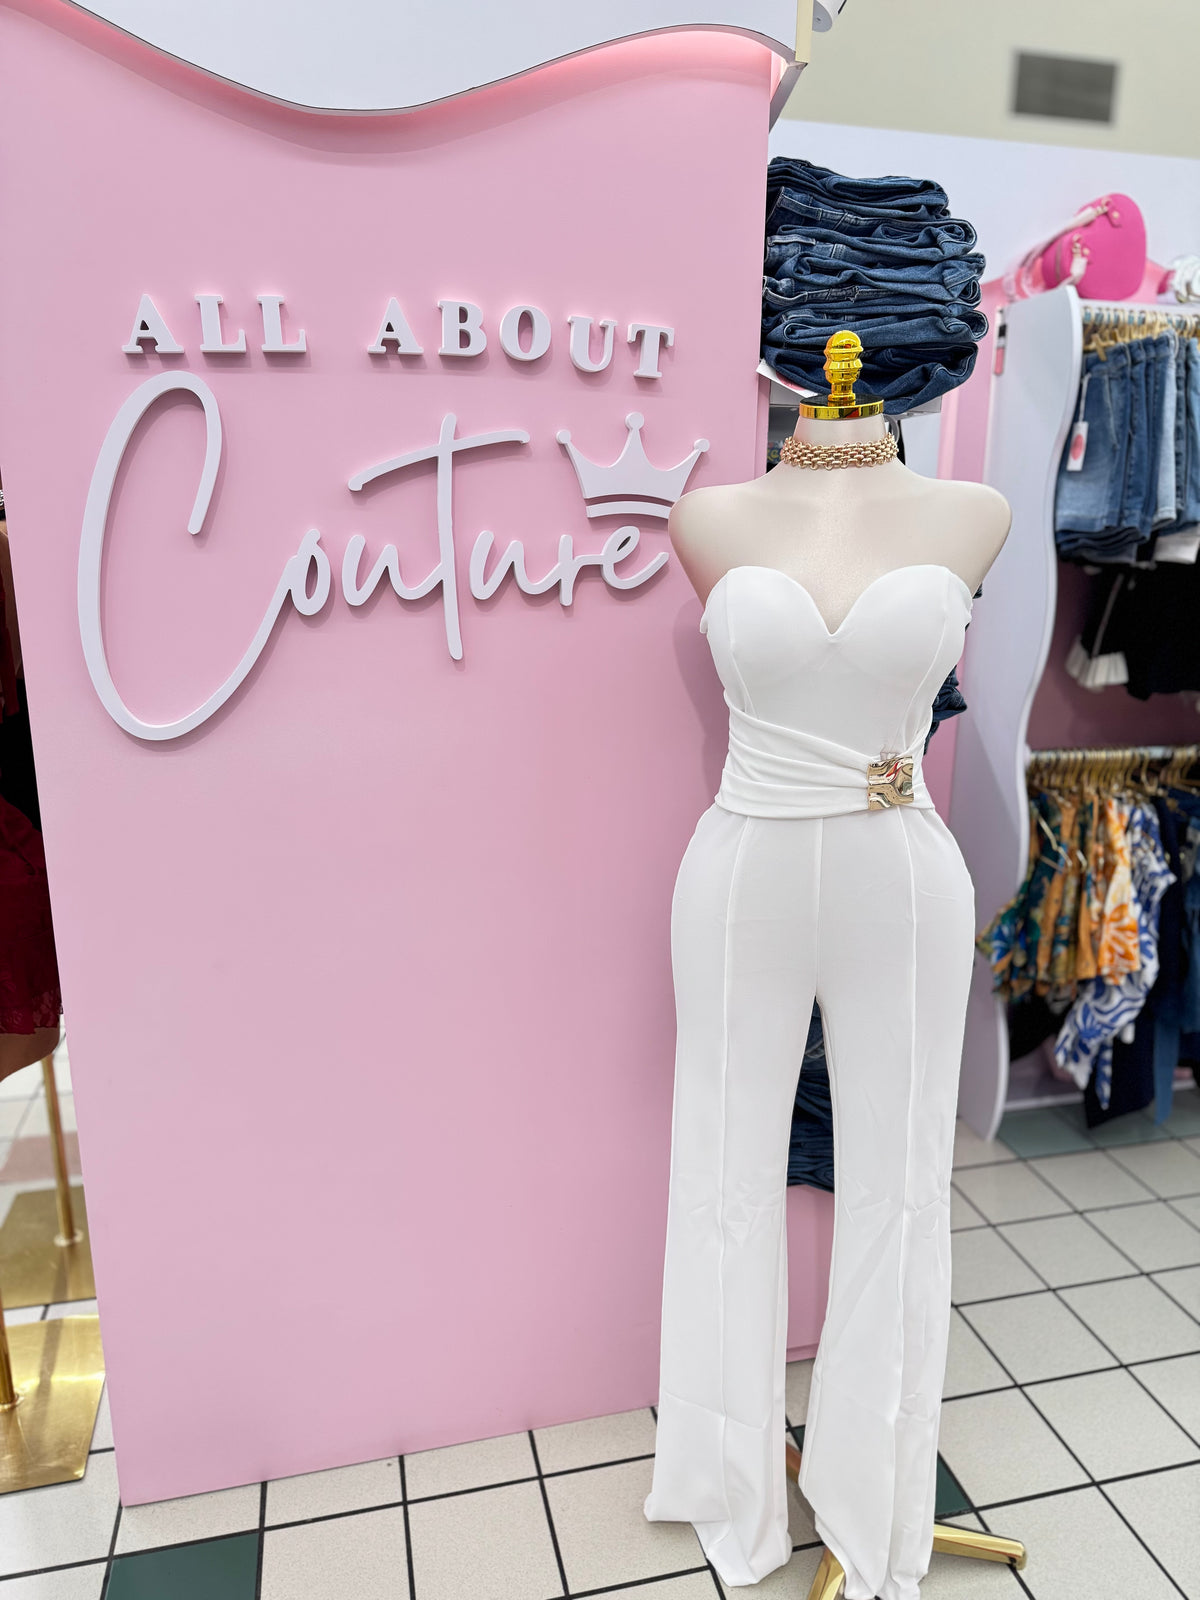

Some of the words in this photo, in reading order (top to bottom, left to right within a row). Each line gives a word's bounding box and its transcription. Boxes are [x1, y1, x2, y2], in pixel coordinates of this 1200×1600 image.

[122, 293, 307, 354] ALL
[368, 297, 675, 379] ABOUT
[77, 370, 669, 741] Couture
